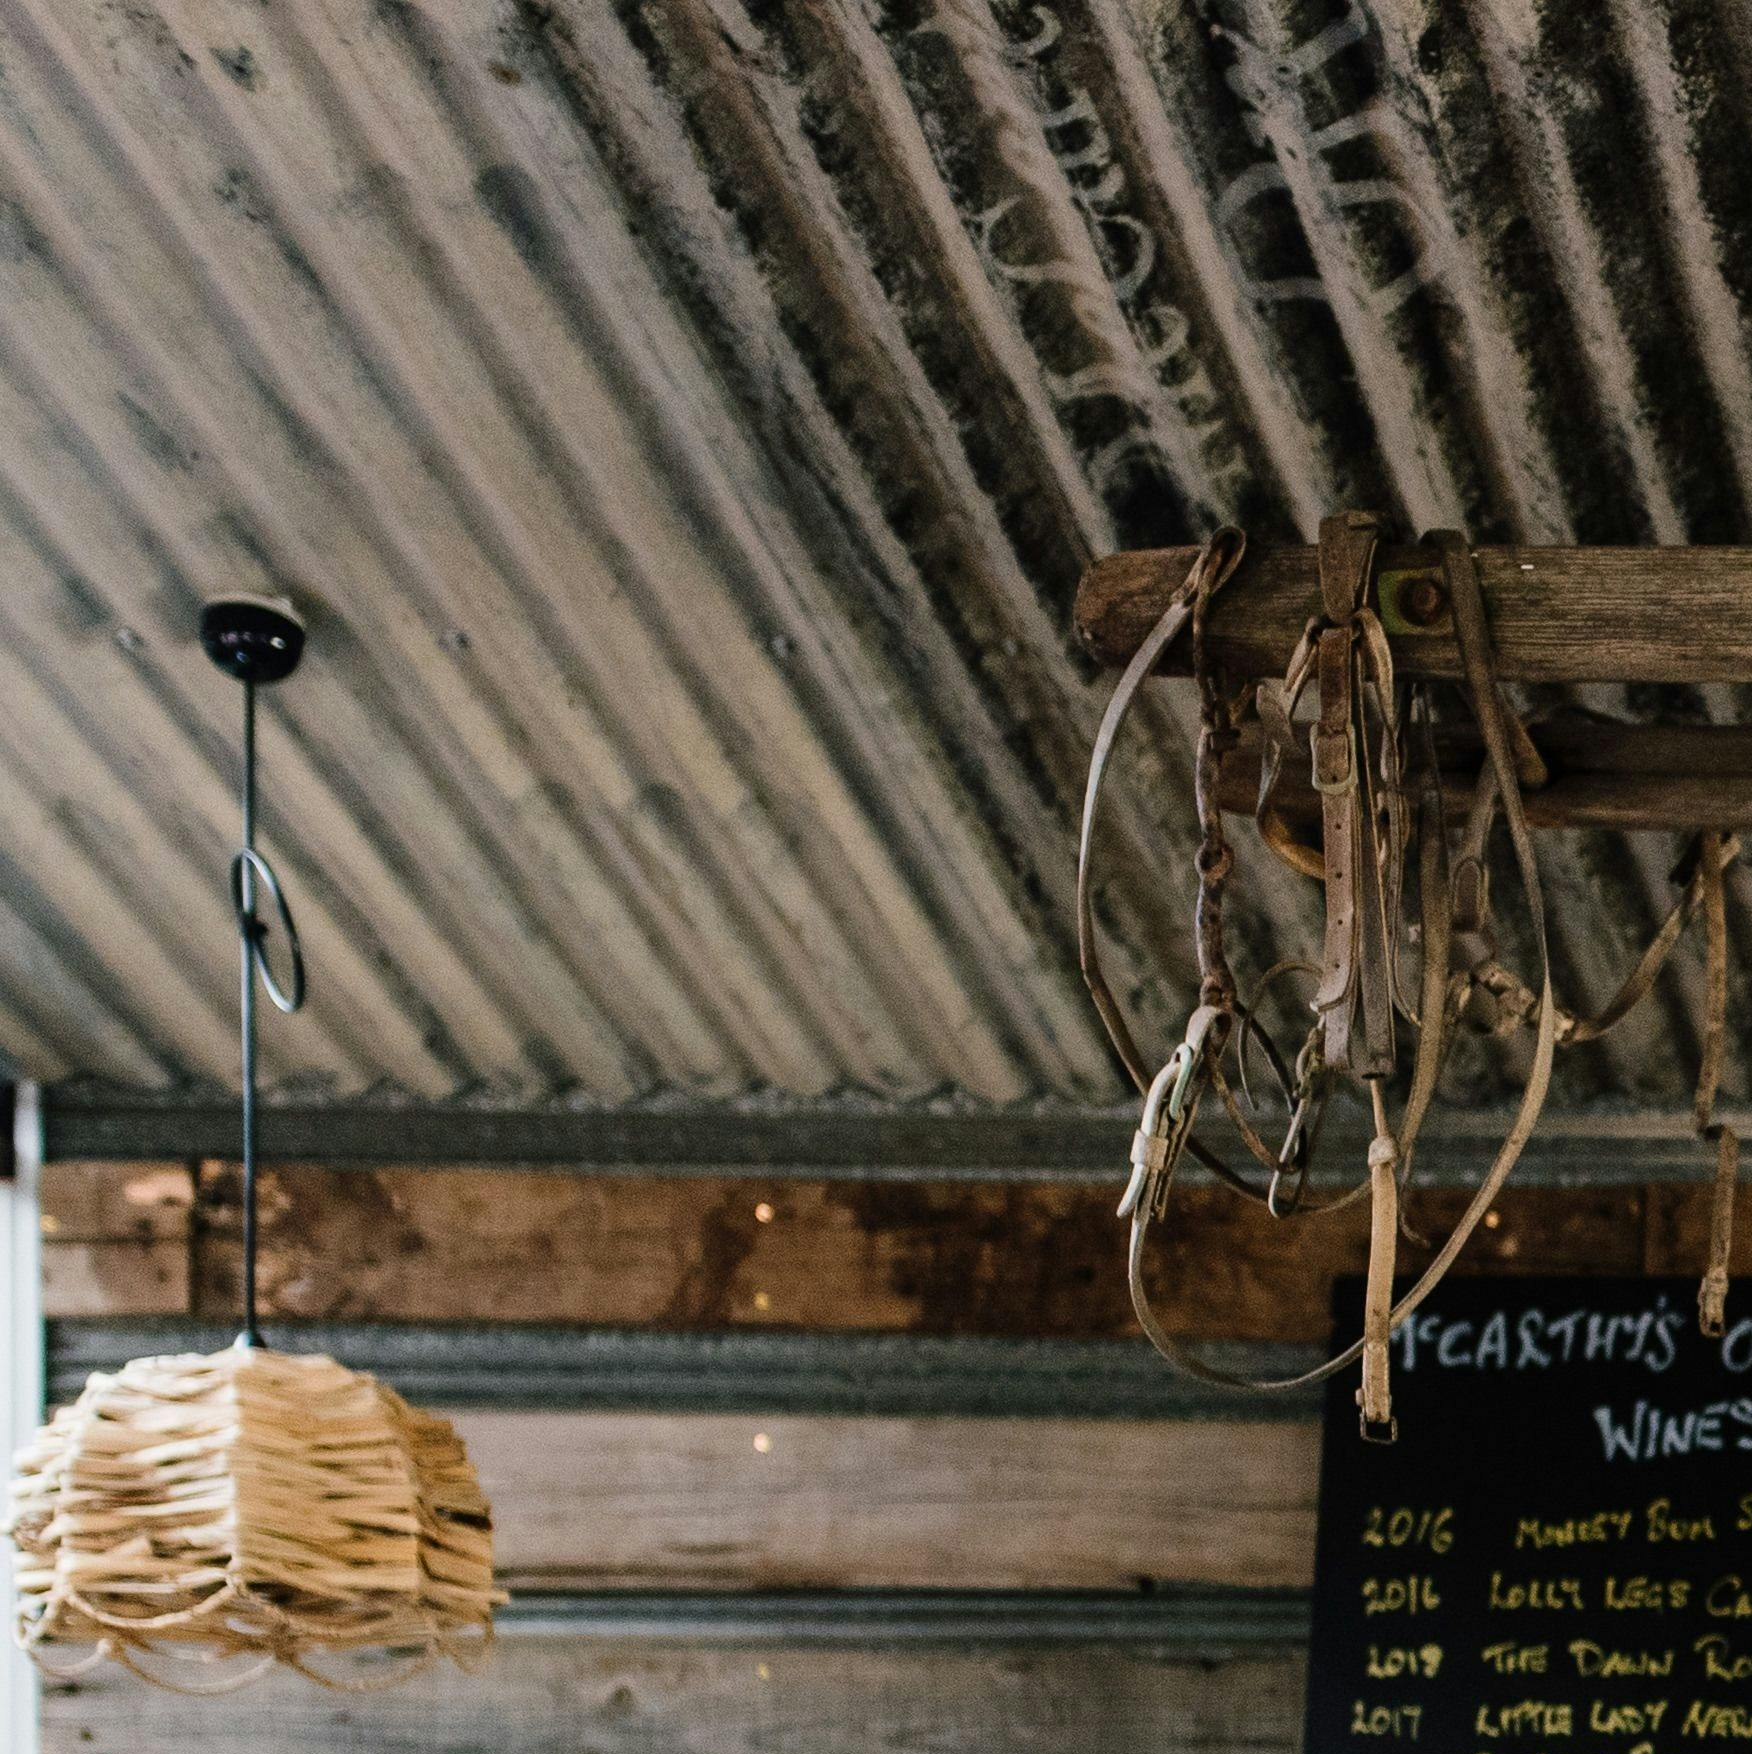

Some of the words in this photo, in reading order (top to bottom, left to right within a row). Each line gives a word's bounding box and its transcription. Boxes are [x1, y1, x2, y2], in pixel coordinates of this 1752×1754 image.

[1363, 1506, 1455, 1553] 2016
[1362, 1574, 1441, 1616] 2016
[1353, 1701, 1424, 1742] 2017
